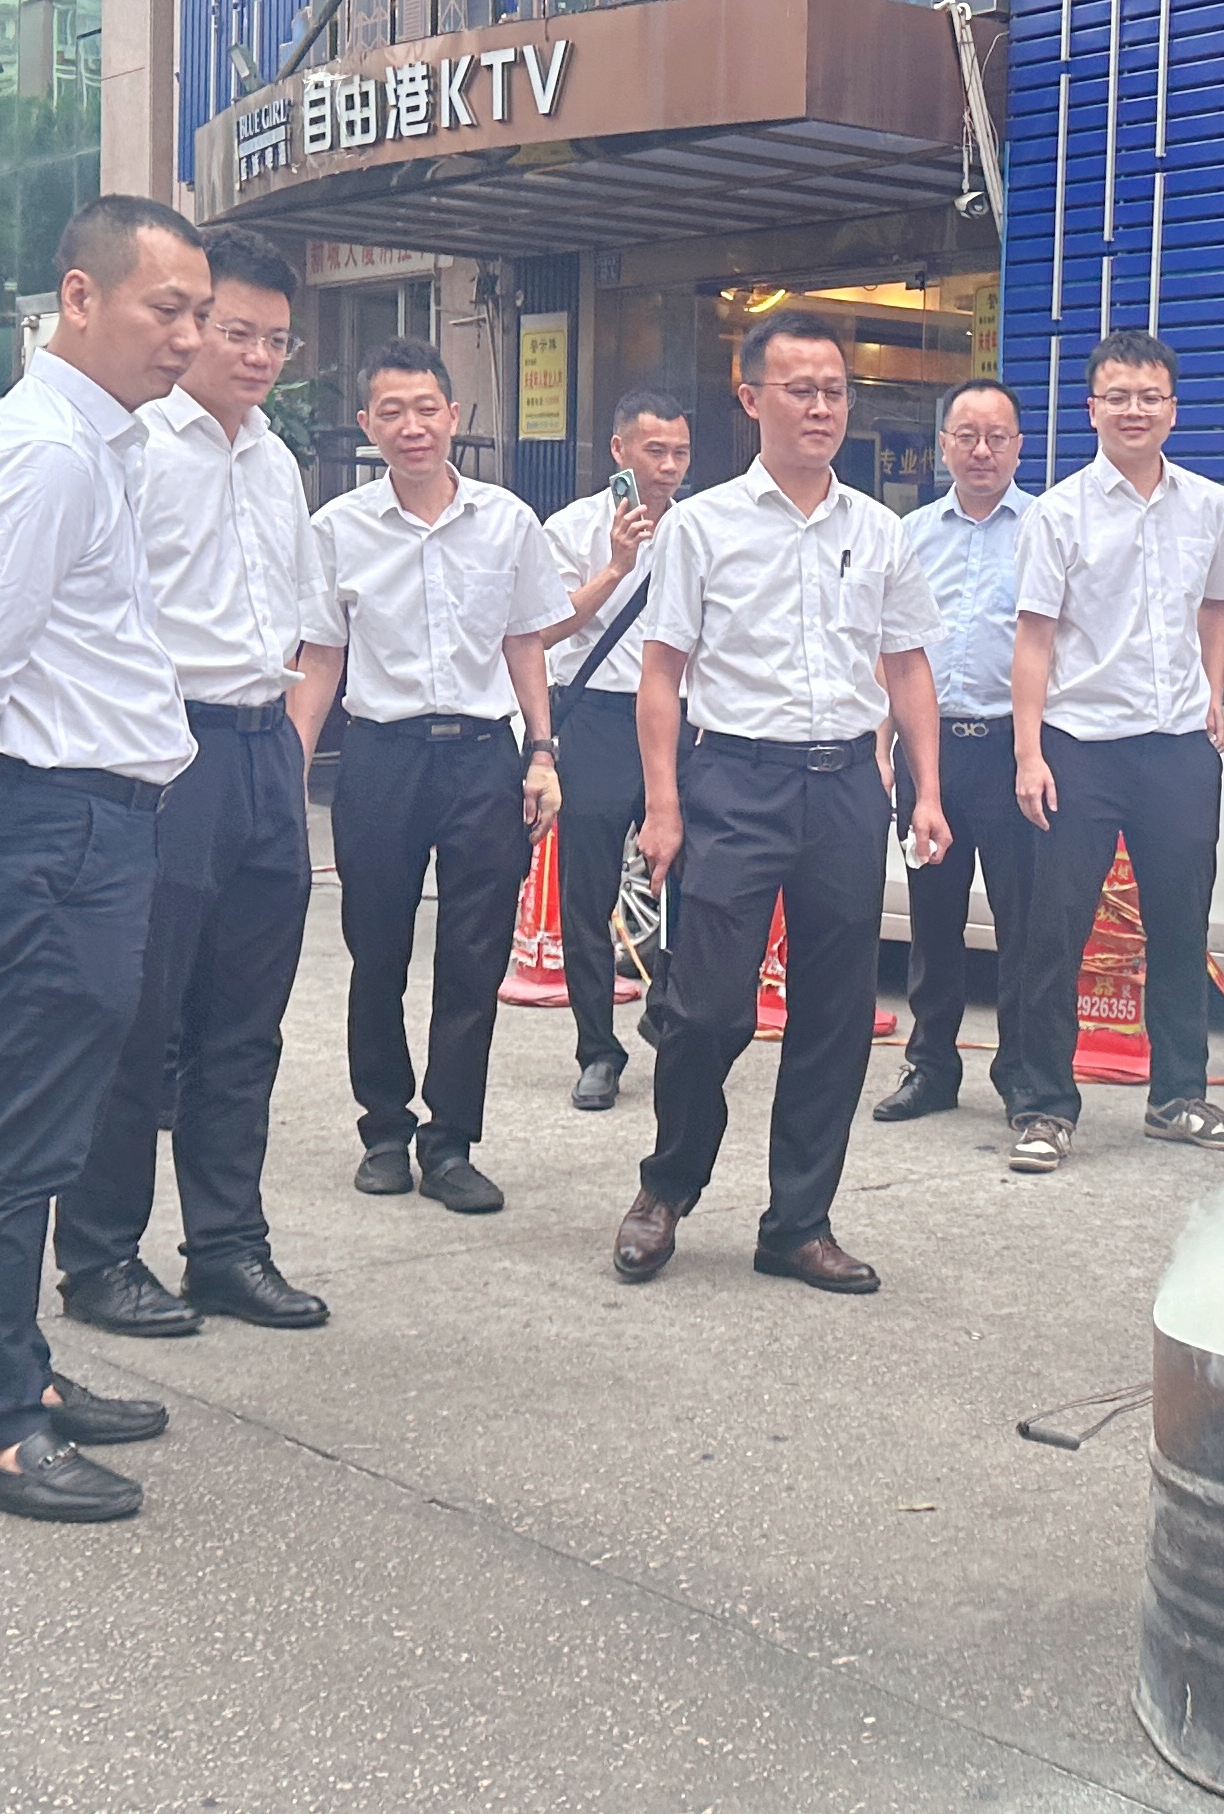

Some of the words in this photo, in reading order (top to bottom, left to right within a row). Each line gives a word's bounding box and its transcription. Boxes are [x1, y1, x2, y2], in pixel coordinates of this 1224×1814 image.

[239, 109, 261, 140] BLUE
[261, 98, 288, 130] GIRL
[303, 39, 571, 154] 自由港KTV
